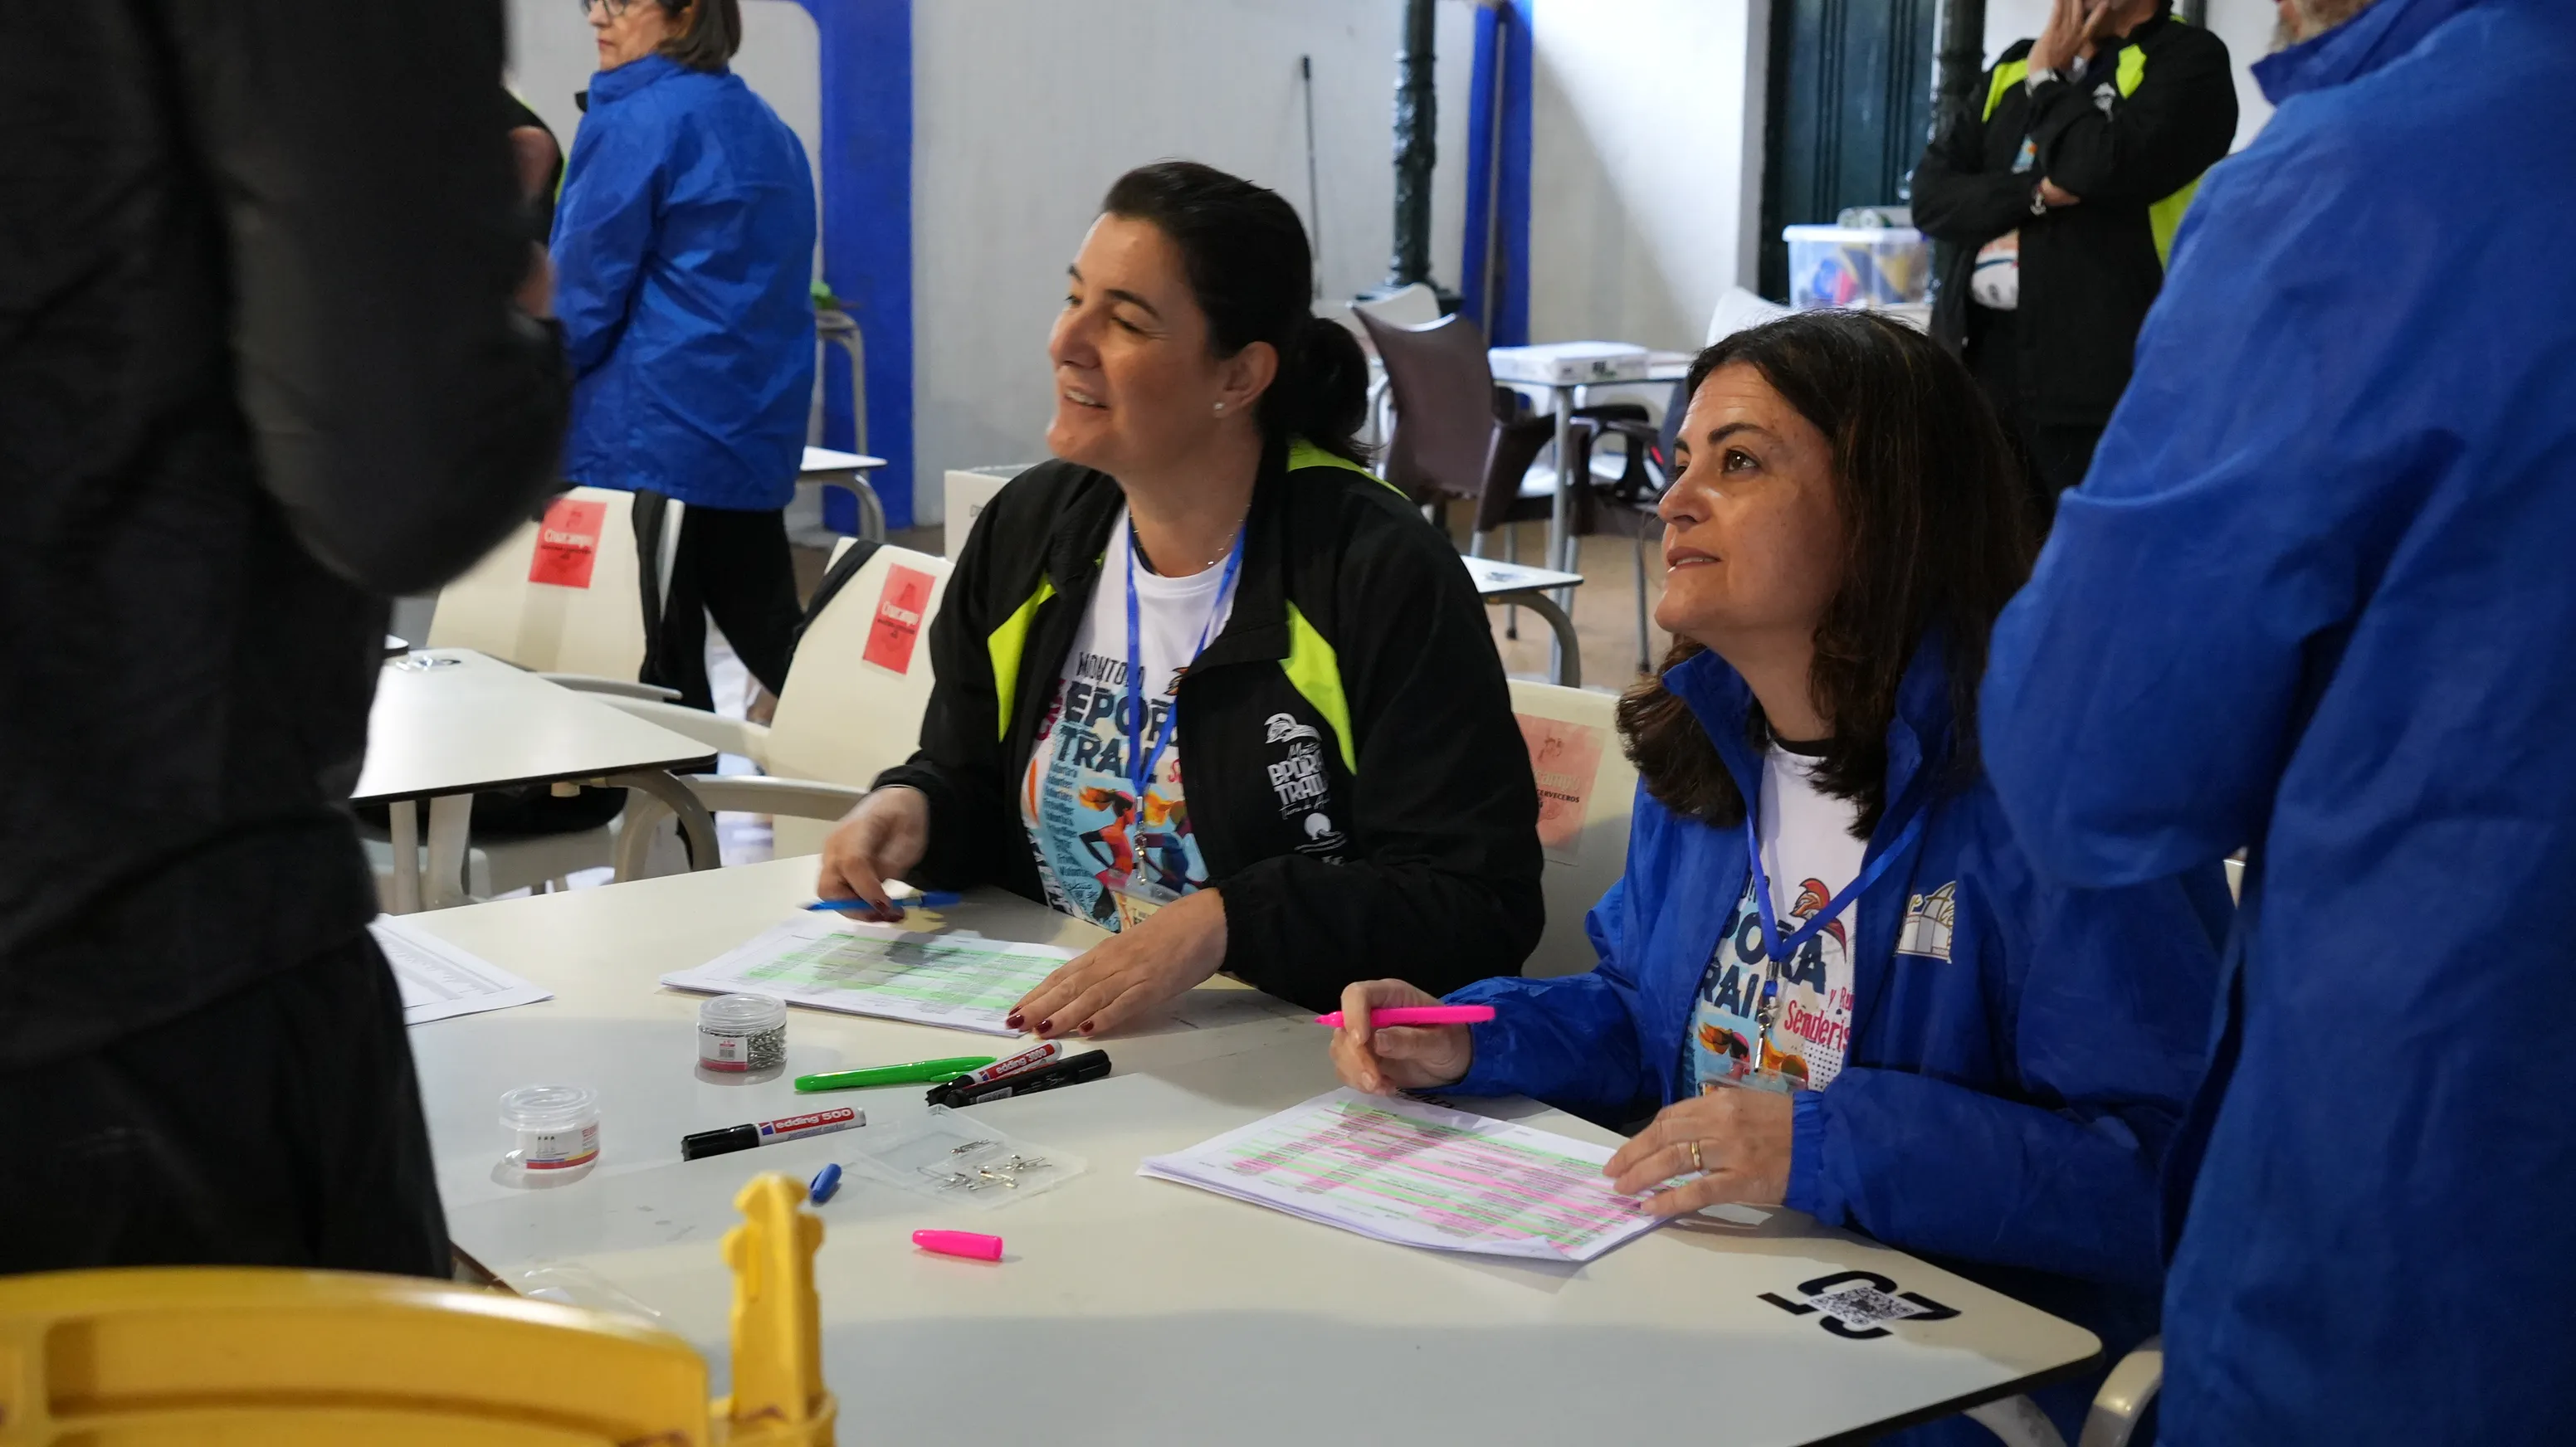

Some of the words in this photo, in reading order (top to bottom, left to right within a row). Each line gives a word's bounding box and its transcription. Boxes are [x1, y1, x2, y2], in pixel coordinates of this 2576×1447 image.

[1065, 680, 1179, 747] EPOR
[1056, 724, 1158, 784] TRAL
[996, 1056, 1027, 1074] edding
[775, 1114, 820, 1129] edding
[821, 1108, 852, 1121] 500
